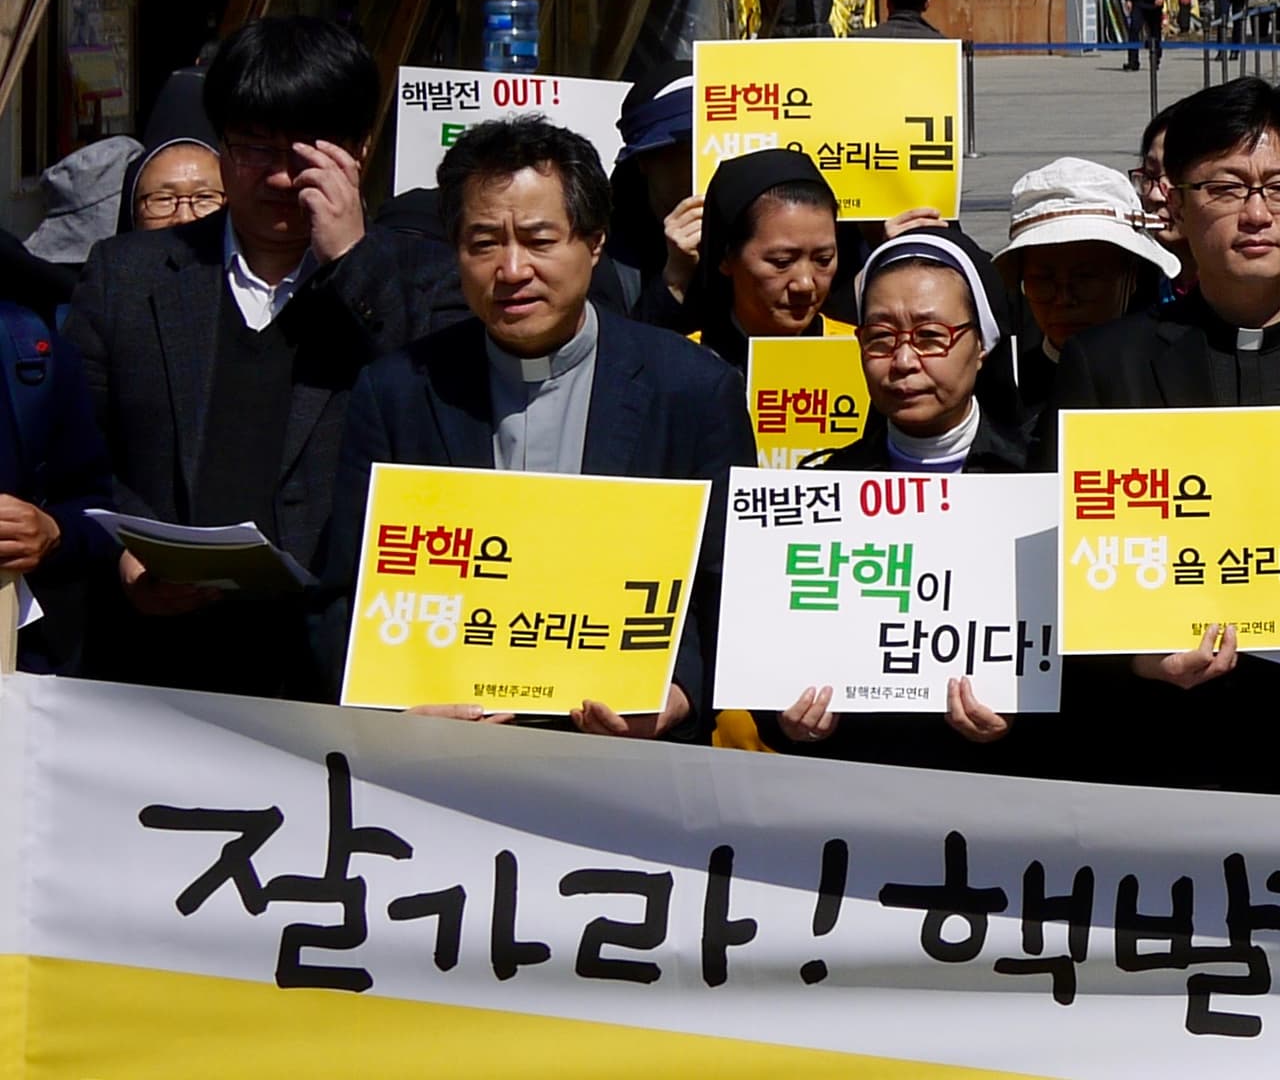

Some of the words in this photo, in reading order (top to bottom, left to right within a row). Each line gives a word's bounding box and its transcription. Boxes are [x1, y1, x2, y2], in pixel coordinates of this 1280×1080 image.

[401, 80, 480, 111] 핵발전
[493, 78, 560, 107] OUT!
[705, 83, 812, 121] 탈핵은
[817, 142, 899, 170] 살리는
[905, 115, 954, 171] 길
[757, 388, 859, 434] 탈핵은
[732, 482, 842, 528] 핵발전
[859, 477, 951, 517] OUT!
[1073, 468, 1212, 519] 탈핵은
[376, 524, 512, 579] 탈핵은
[785, 541, 952, 613] 탈핵이
[1070, 535, 1206, 590] 생명을
[365, 591, 497, 648] 생명을
[508, 612, 609, 650] 살리는
[620, 579, 683, 651] 길
[878, 620, 1053, 676] 답이다!
[473, 683, 554, 698] 탈핵천주교연대
[845, 685, 930, 700] 탈핵천주교연대
[139, 750, 849, 994] 잘가라!
